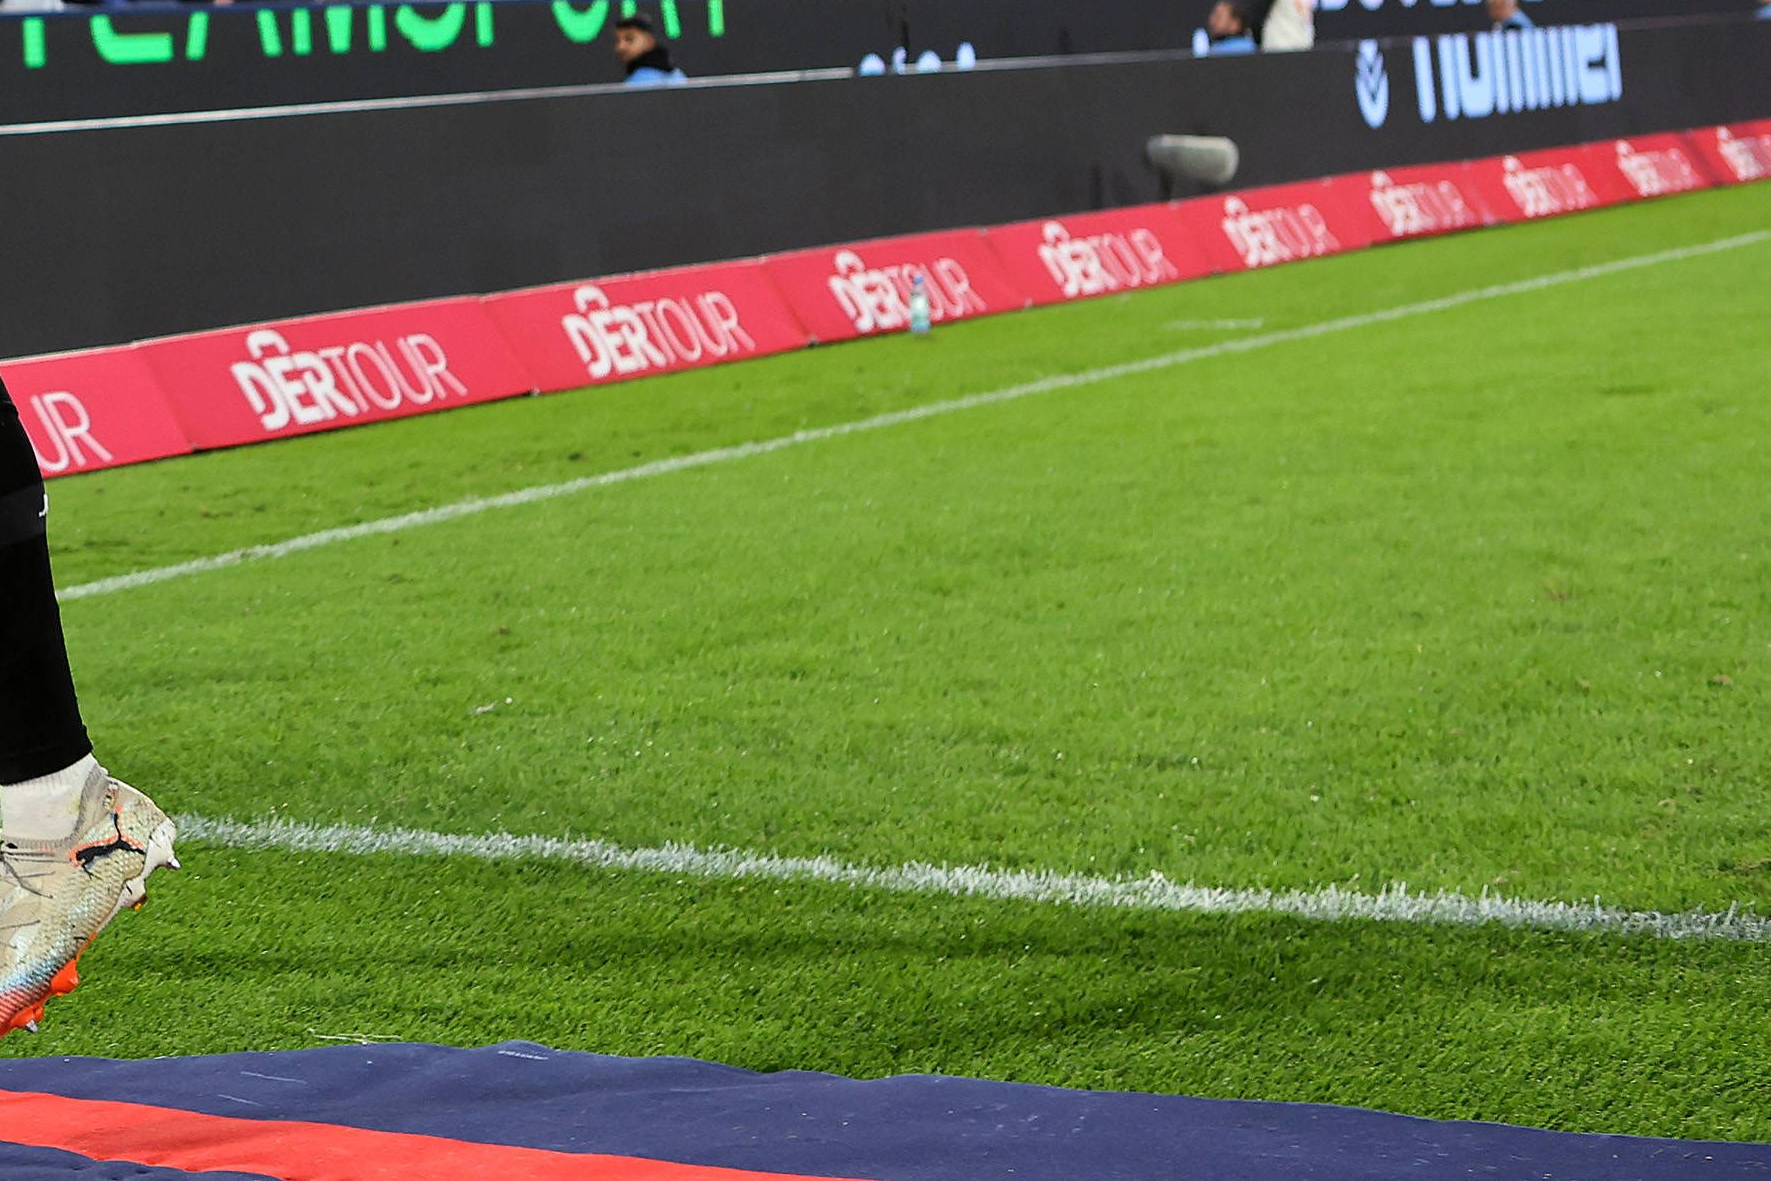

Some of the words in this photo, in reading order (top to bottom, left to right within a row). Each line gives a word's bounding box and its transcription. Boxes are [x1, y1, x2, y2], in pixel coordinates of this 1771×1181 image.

[1038, 225, 1179, 297] DERTOUR
[562, 289, 757, 379] DERTOUR
[231, 330, 468, 431] DERTOUR
